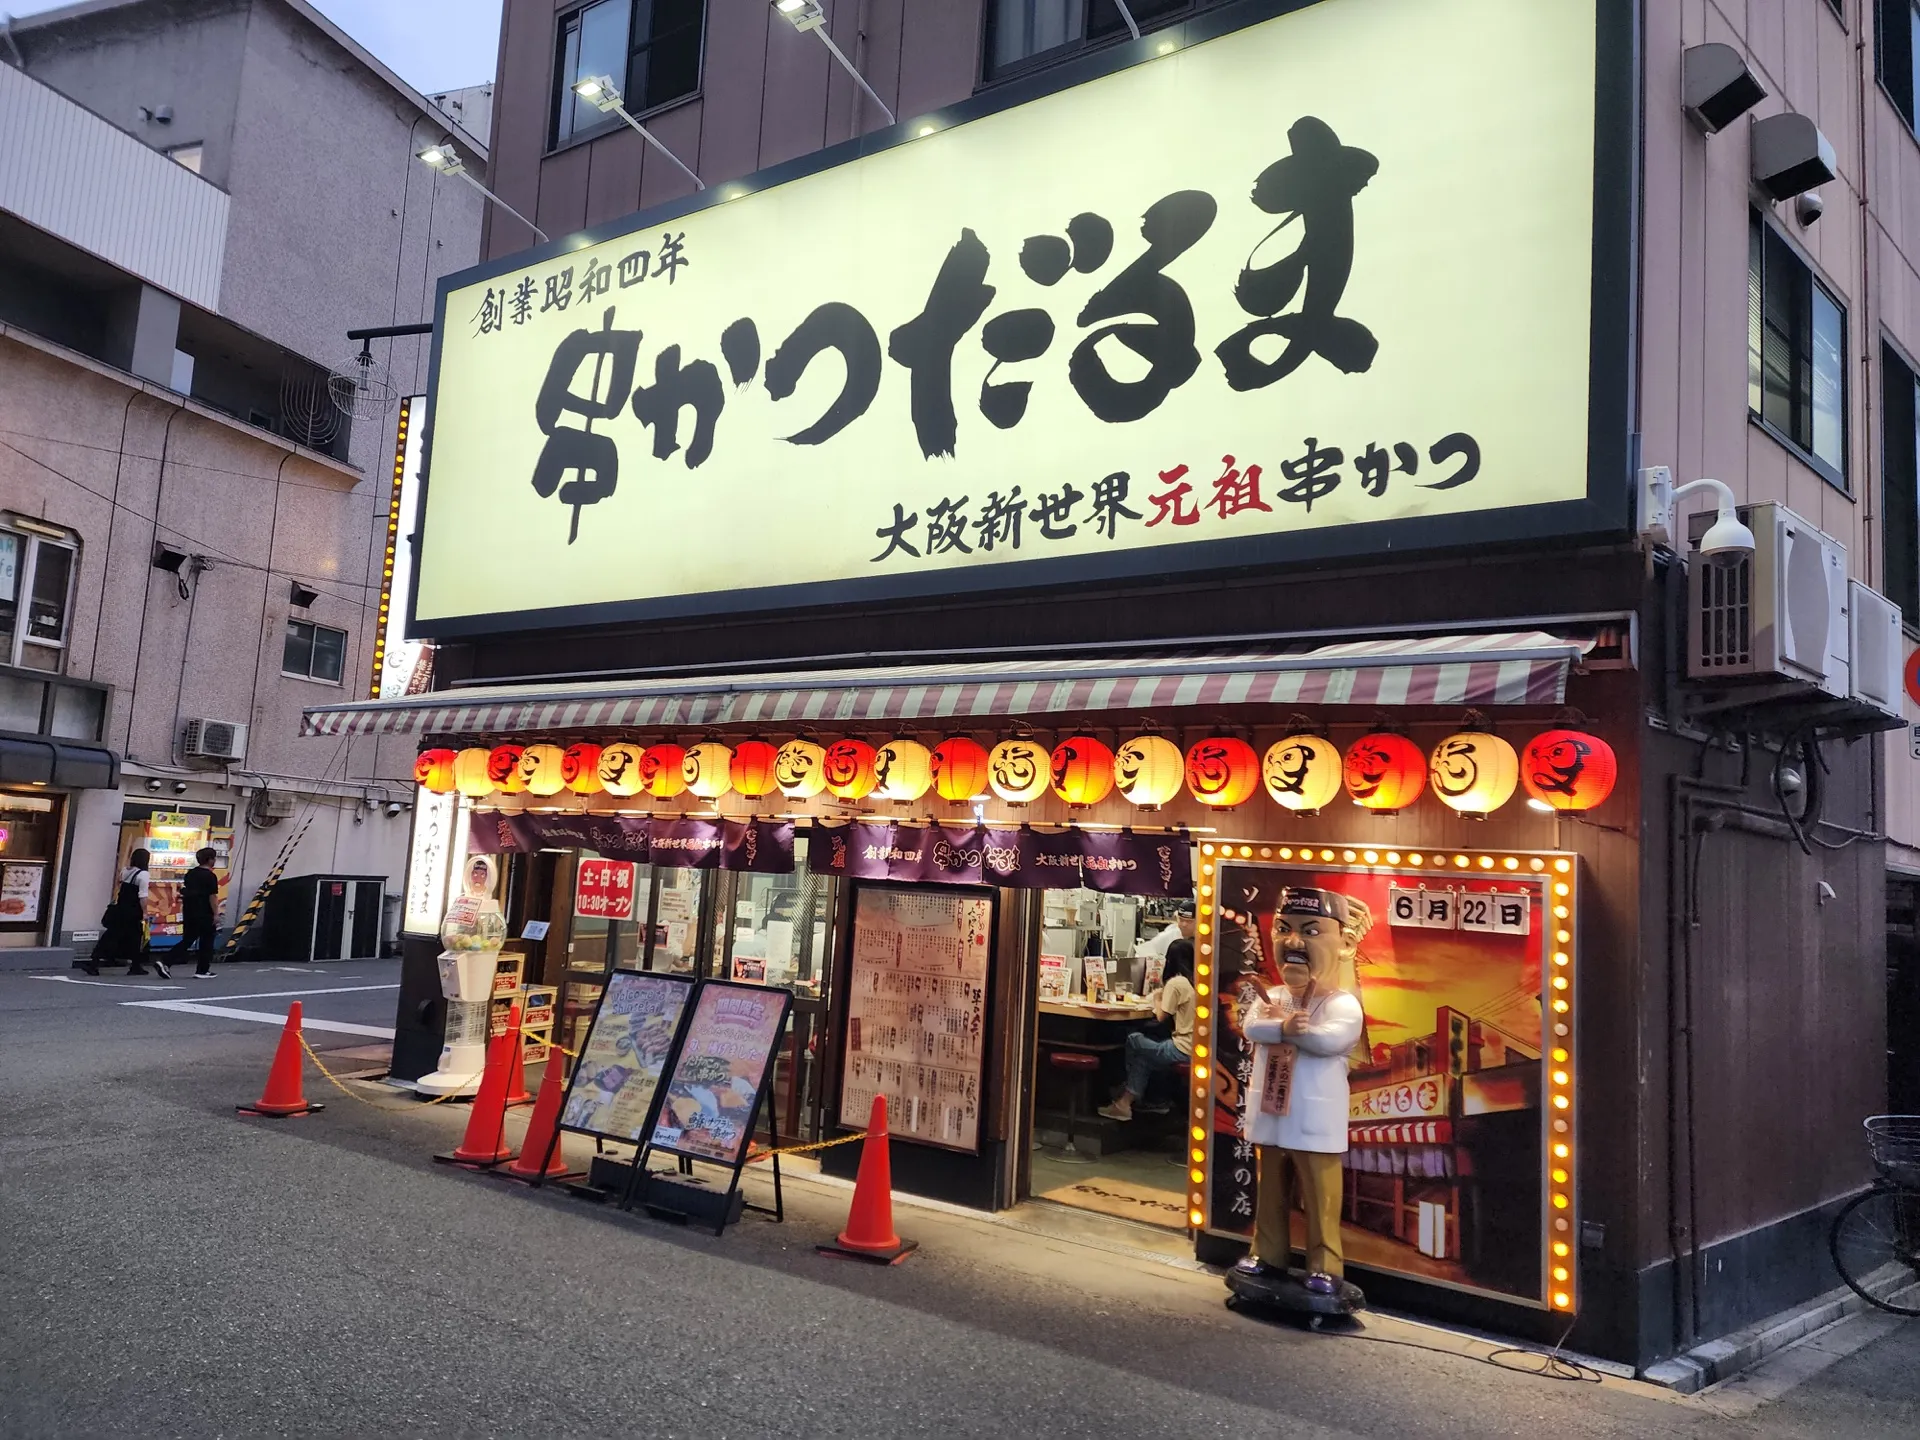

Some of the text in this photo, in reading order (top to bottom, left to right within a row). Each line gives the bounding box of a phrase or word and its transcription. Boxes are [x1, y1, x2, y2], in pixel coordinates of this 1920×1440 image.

[469, 232, 690, 339] 創業昭和四年
[531, 116, 1380, 545] 串かつだるま
[870, 433, 1481, 563] 大阪新世界元祖串かつ
[831, 836, 847, 868] 元祖
